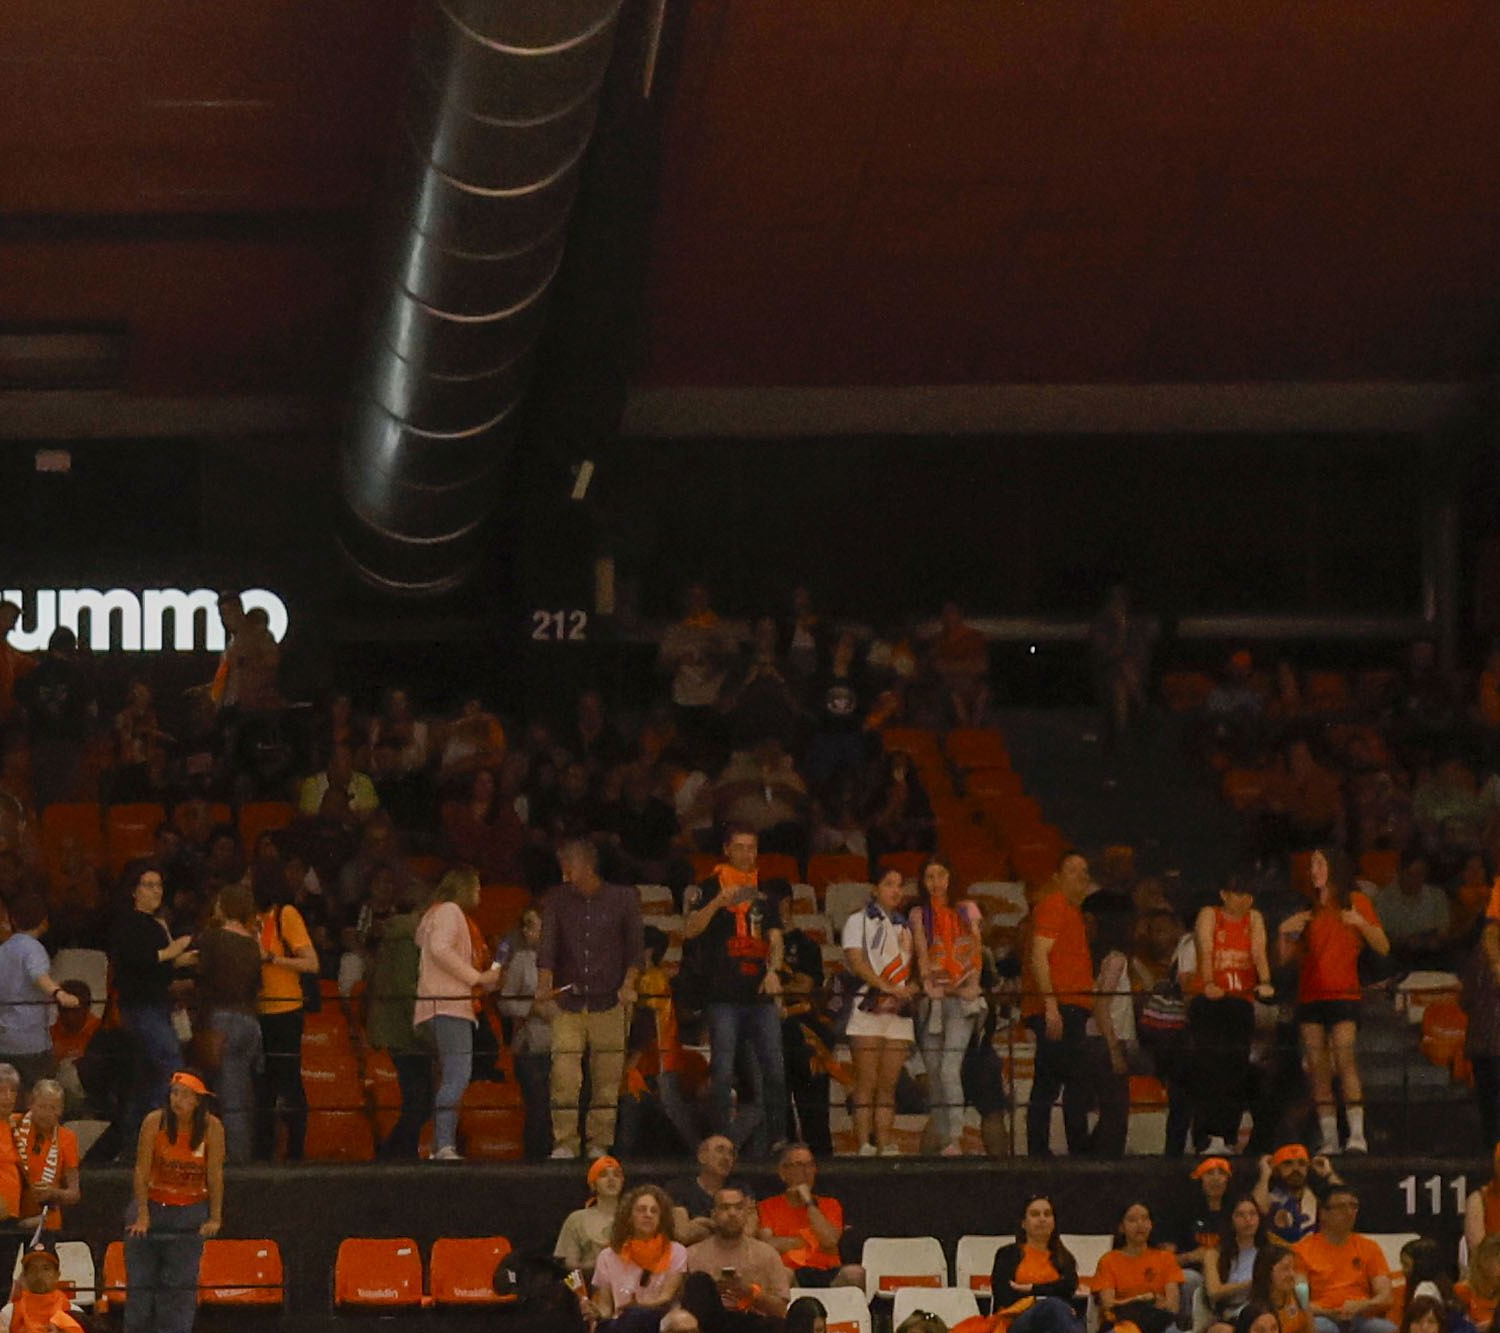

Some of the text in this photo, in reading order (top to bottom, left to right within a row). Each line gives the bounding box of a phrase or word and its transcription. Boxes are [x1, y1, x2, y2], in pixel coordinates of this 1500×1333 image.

[532, 610, 587, 640] 212
[1399, 1175, 1468, 1215] 111
[357, 1287, 400, 1300] Vitaldin
